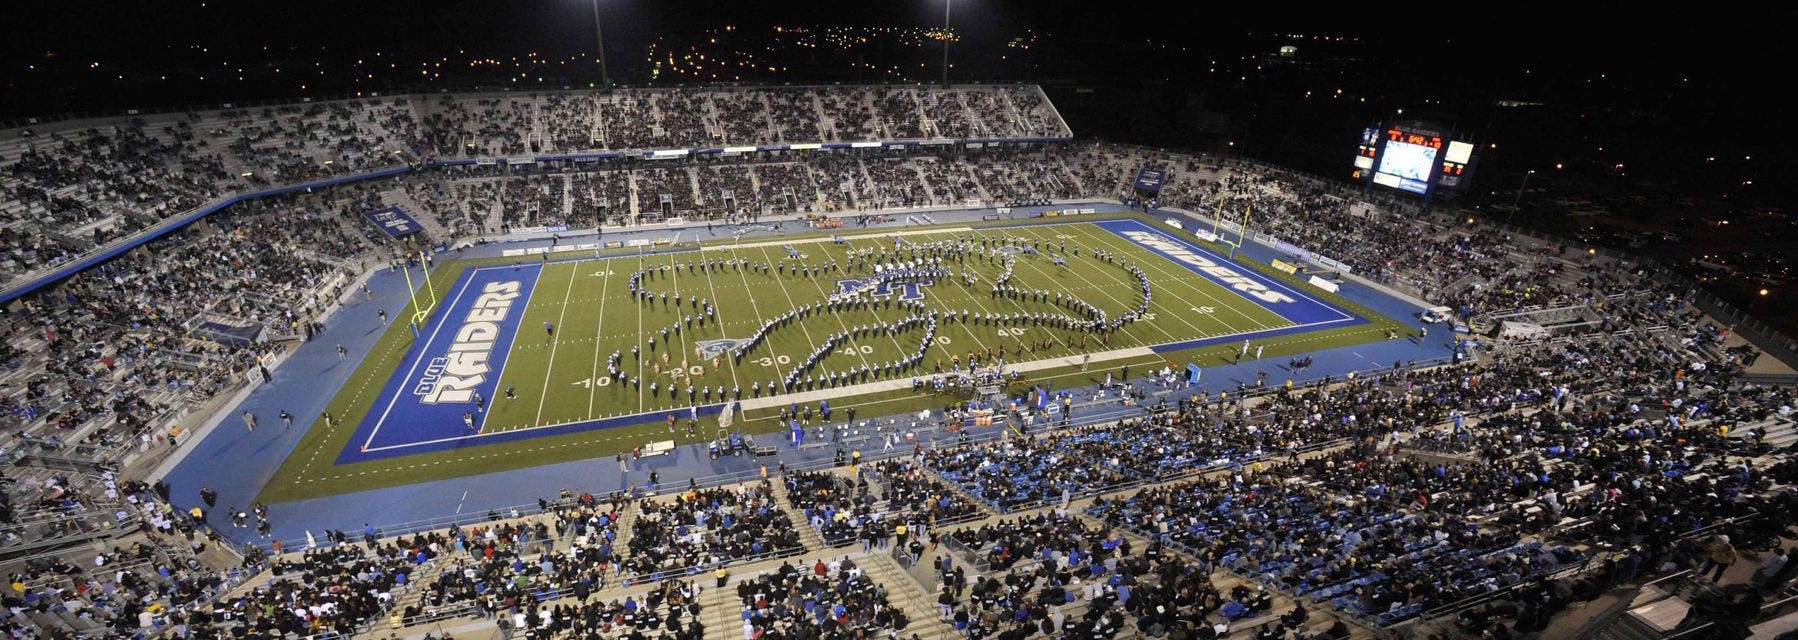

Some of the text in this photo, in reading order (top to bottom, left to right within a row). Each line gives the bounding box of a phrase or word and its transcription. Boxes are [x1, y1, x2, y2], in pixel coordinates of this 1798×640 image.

[1121, 231, 1297, 304] RAIDERS
[419, 280, 521, 405] RAIDERS
[998, 327, 1024, 338] 40
[759, 355, 791, 367] 30
[844, 345, 874, 356] 40
[413, 356, 451, 396] BLUE
